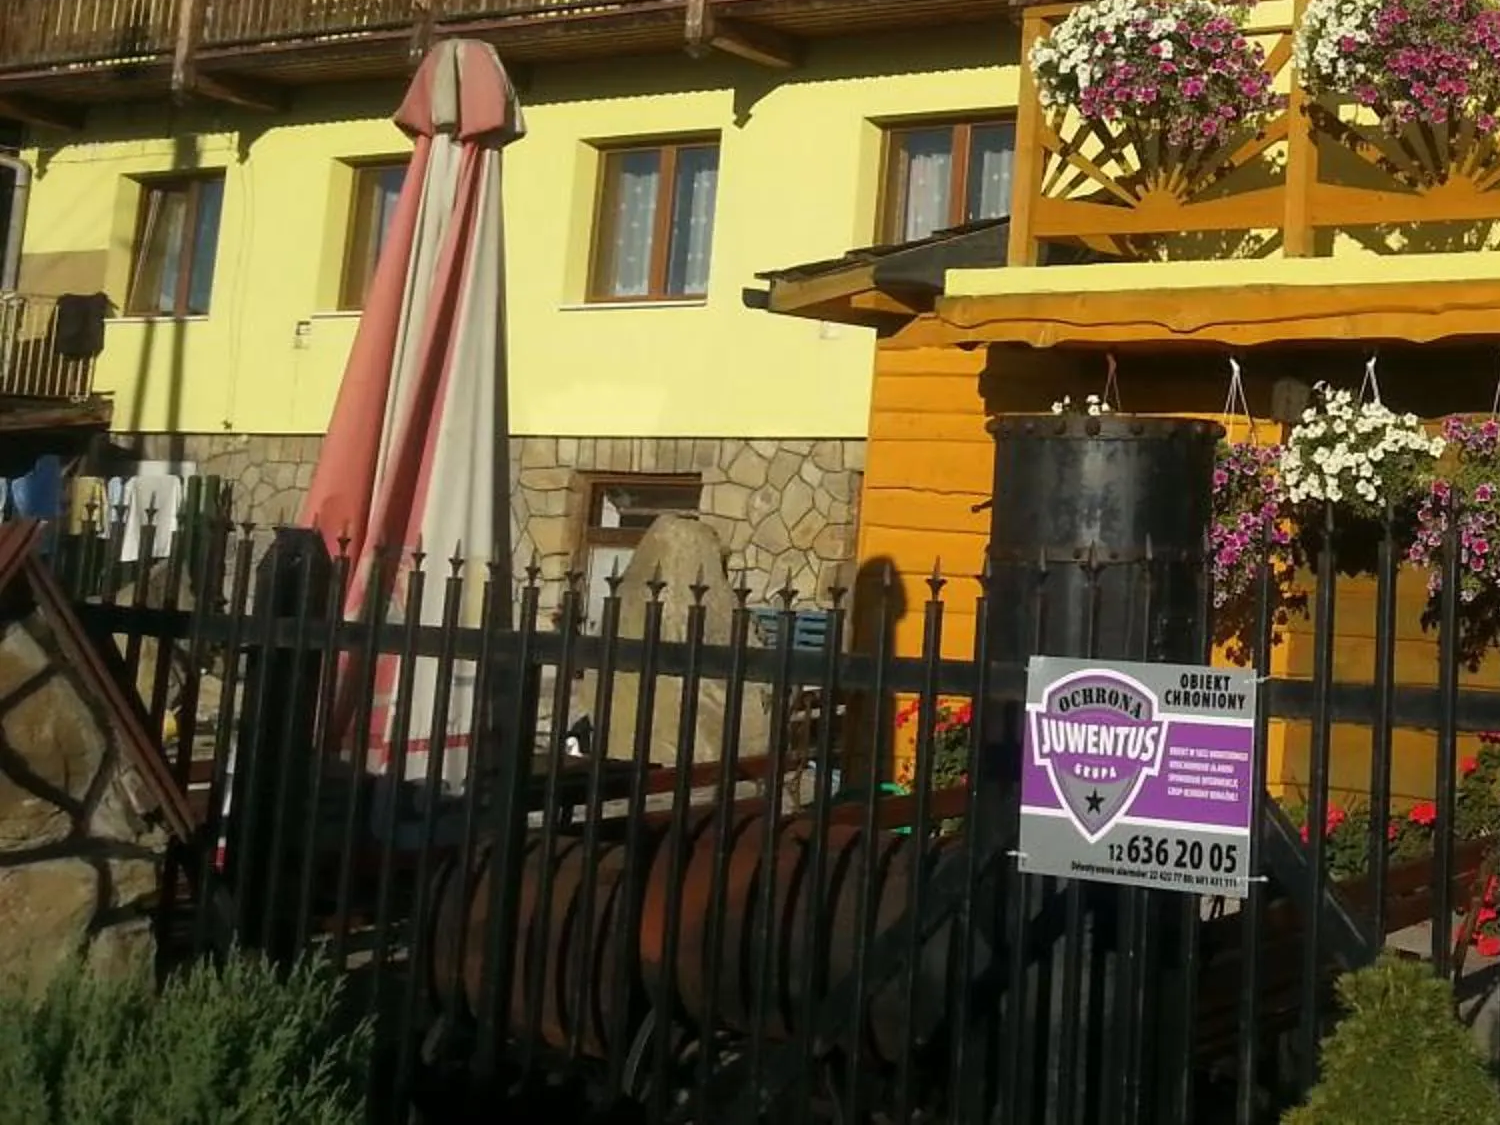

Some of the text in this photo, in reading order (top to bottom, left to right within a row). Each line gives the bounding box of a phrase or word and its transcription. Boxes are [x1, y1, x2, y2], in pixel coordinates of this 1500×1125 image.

[1180, 673, 1231, 692] OBIEKT
[1059, 687, 1144, 719] OCHRONA
[1164, 690, 1246, 709] CHRONIONY
[1041, 718, 1159, 762] JUWENTUS
[1074, 763, 1118, 779] GRUPA
[1108, 843, 1124, 862] 12
[1127, 835, 1169, 866] 636
[1175, 840, 1204, 870] 20
[1209, 844, 1237, 874] 05
